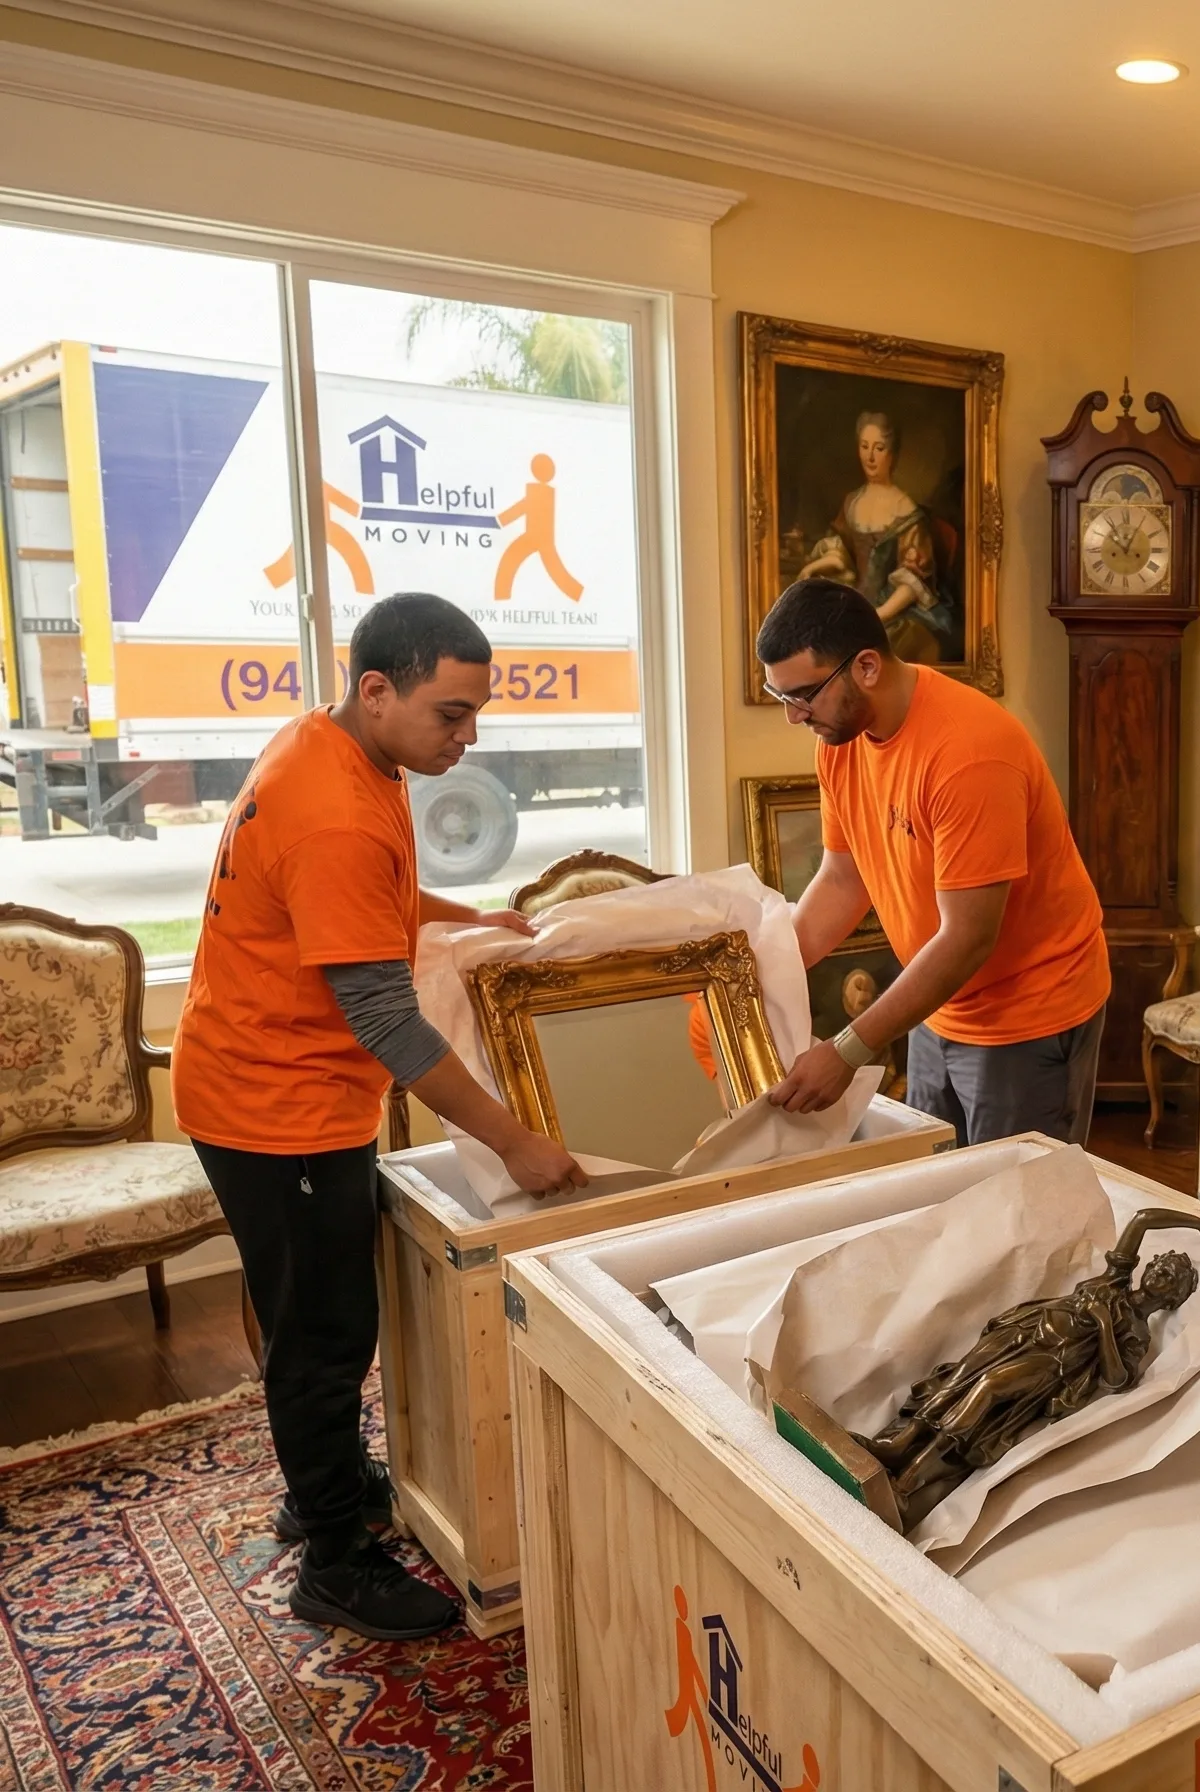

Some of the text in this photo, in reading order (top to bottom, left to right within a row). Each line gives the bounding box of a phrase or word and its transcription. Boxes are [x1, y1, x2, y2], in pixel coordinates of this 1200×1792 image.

[360, 434, 495, 511] Helpful
[365, 526, 493, 548] MOVING
[221, 659, 350, 711] (94)
[709, 1632, 782, 1782] Helpful
[711, 1724, 765, 1792] MOVI
